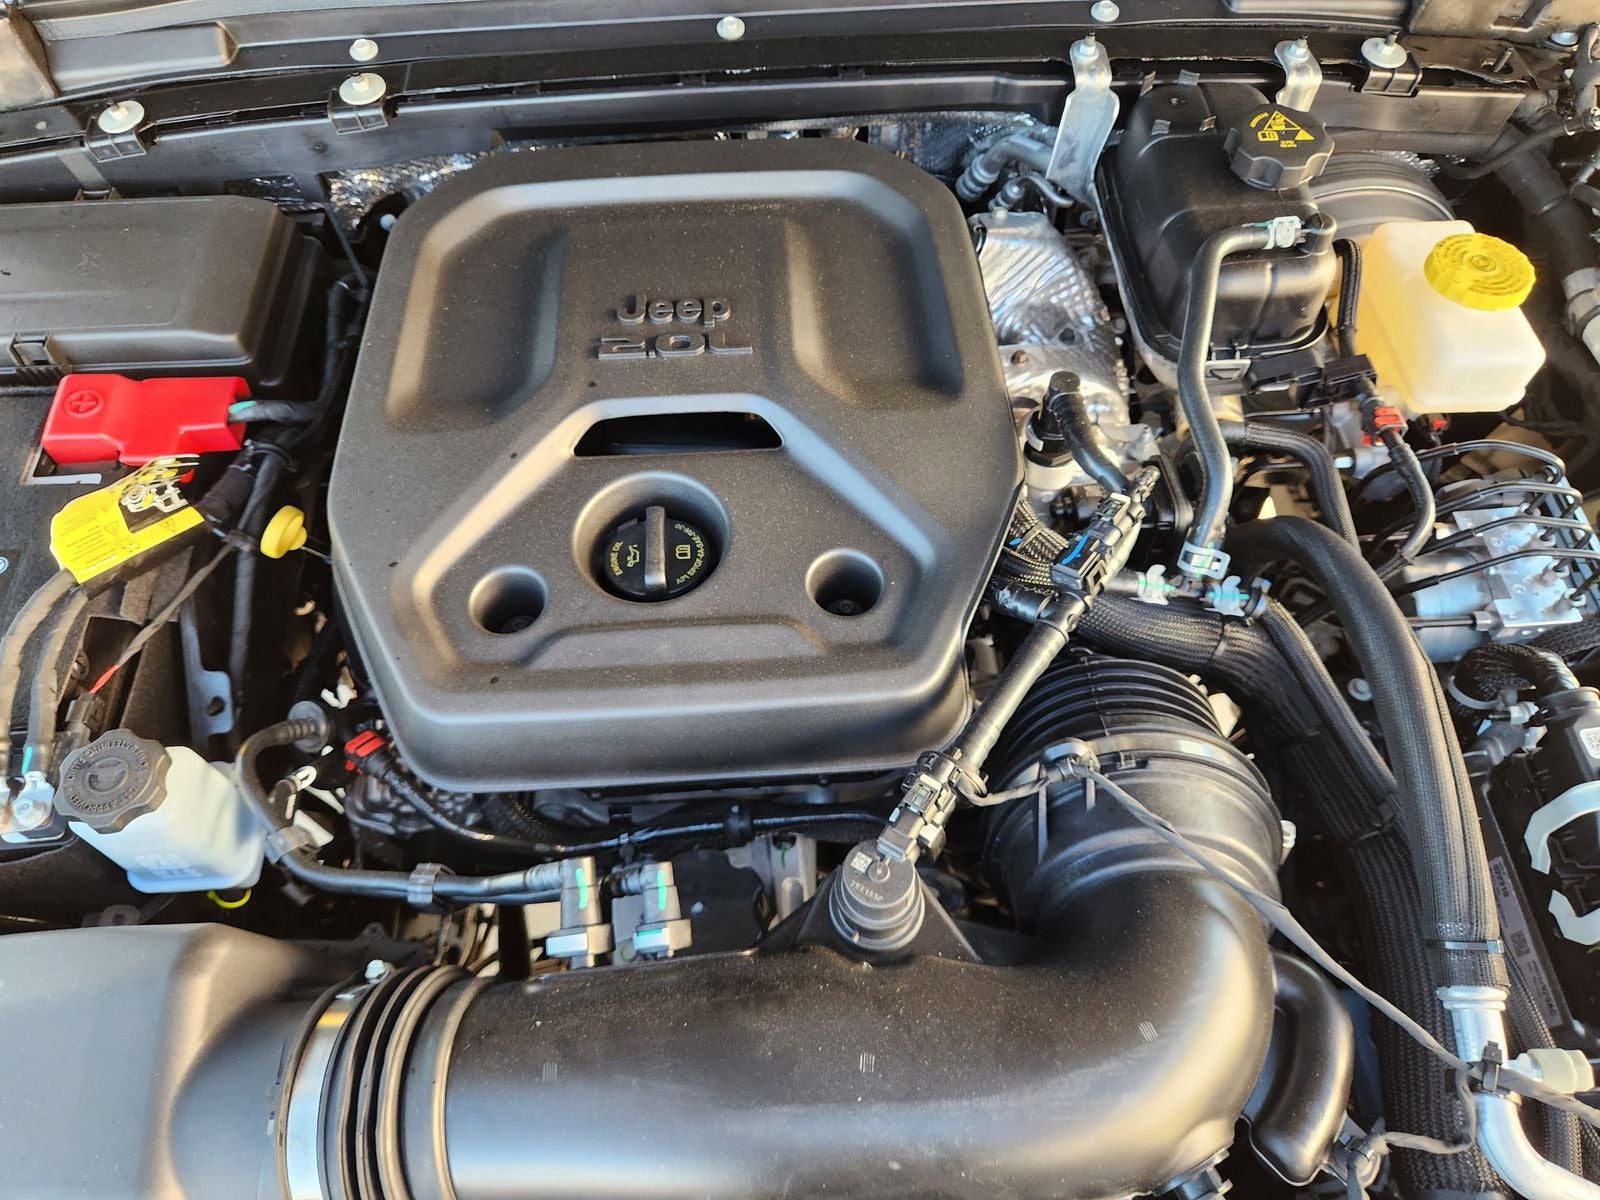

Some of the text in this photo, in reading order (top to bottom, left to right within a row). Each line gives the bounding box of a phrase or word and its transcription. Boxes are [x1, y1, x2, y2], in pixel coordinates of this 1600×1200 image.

[617, 294, 730, 327] Jeep
[599, 330, 753, 360] 2.0L
[610, 541, 624, 576] ENGINE OIL
